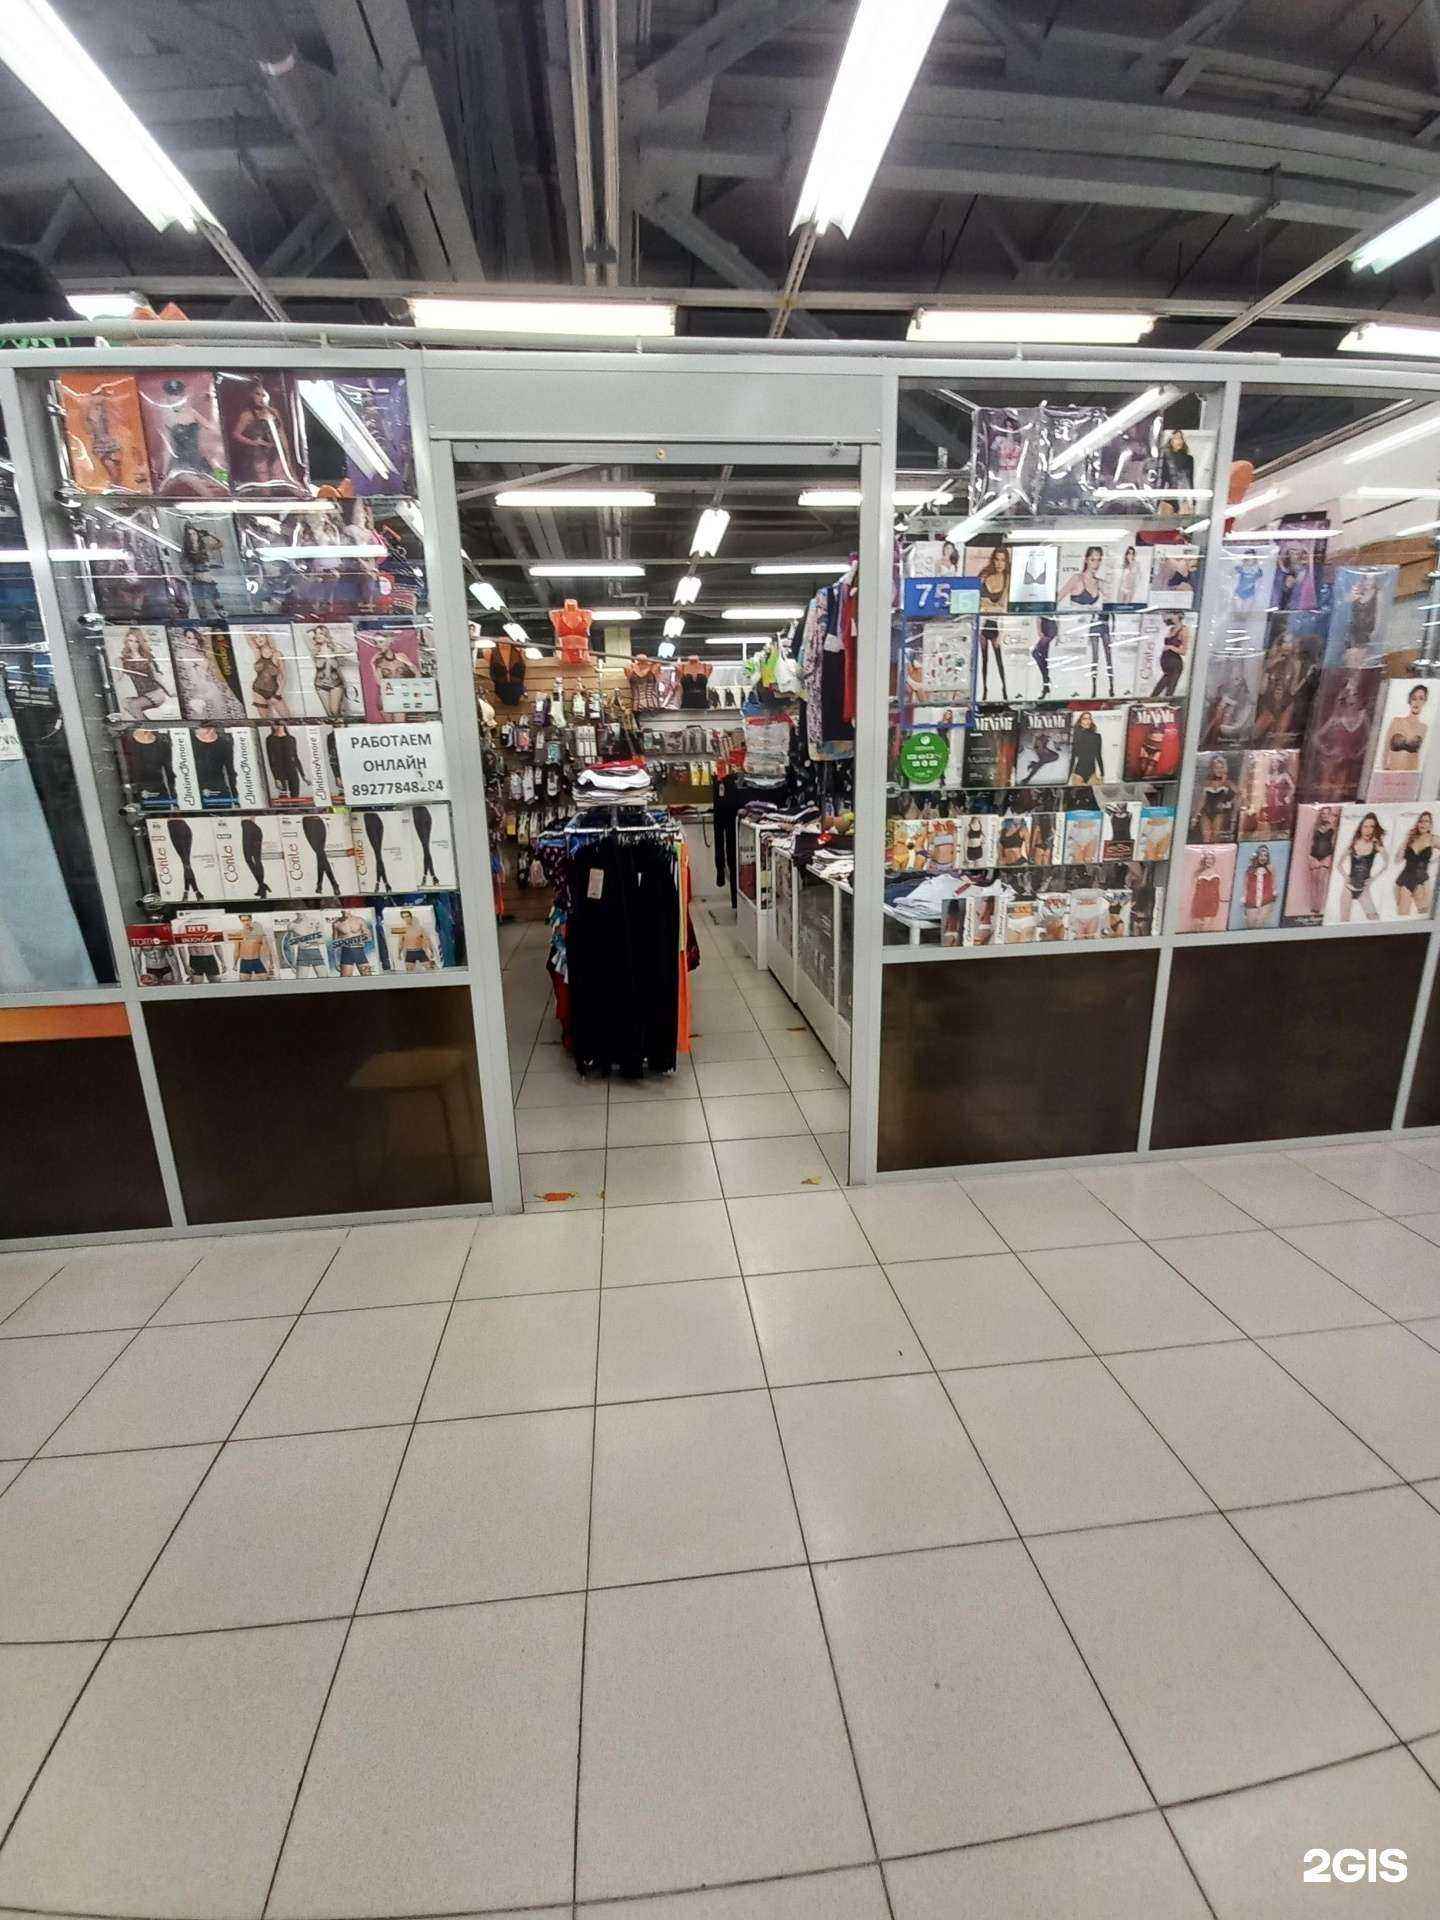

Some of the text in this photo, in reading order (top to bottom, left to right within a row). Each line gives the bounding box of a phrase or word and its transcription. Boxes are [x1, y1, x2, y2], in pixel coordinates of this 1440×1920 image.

[350, 733, 432, 749] РАБОТАЕМ
[363, 754, 428, 773] ОНЛАЙН
[158, 846, 172, 886] Conte
[224, 844, 239, 884] Conte
[289, 842, 304, 882] Conte
